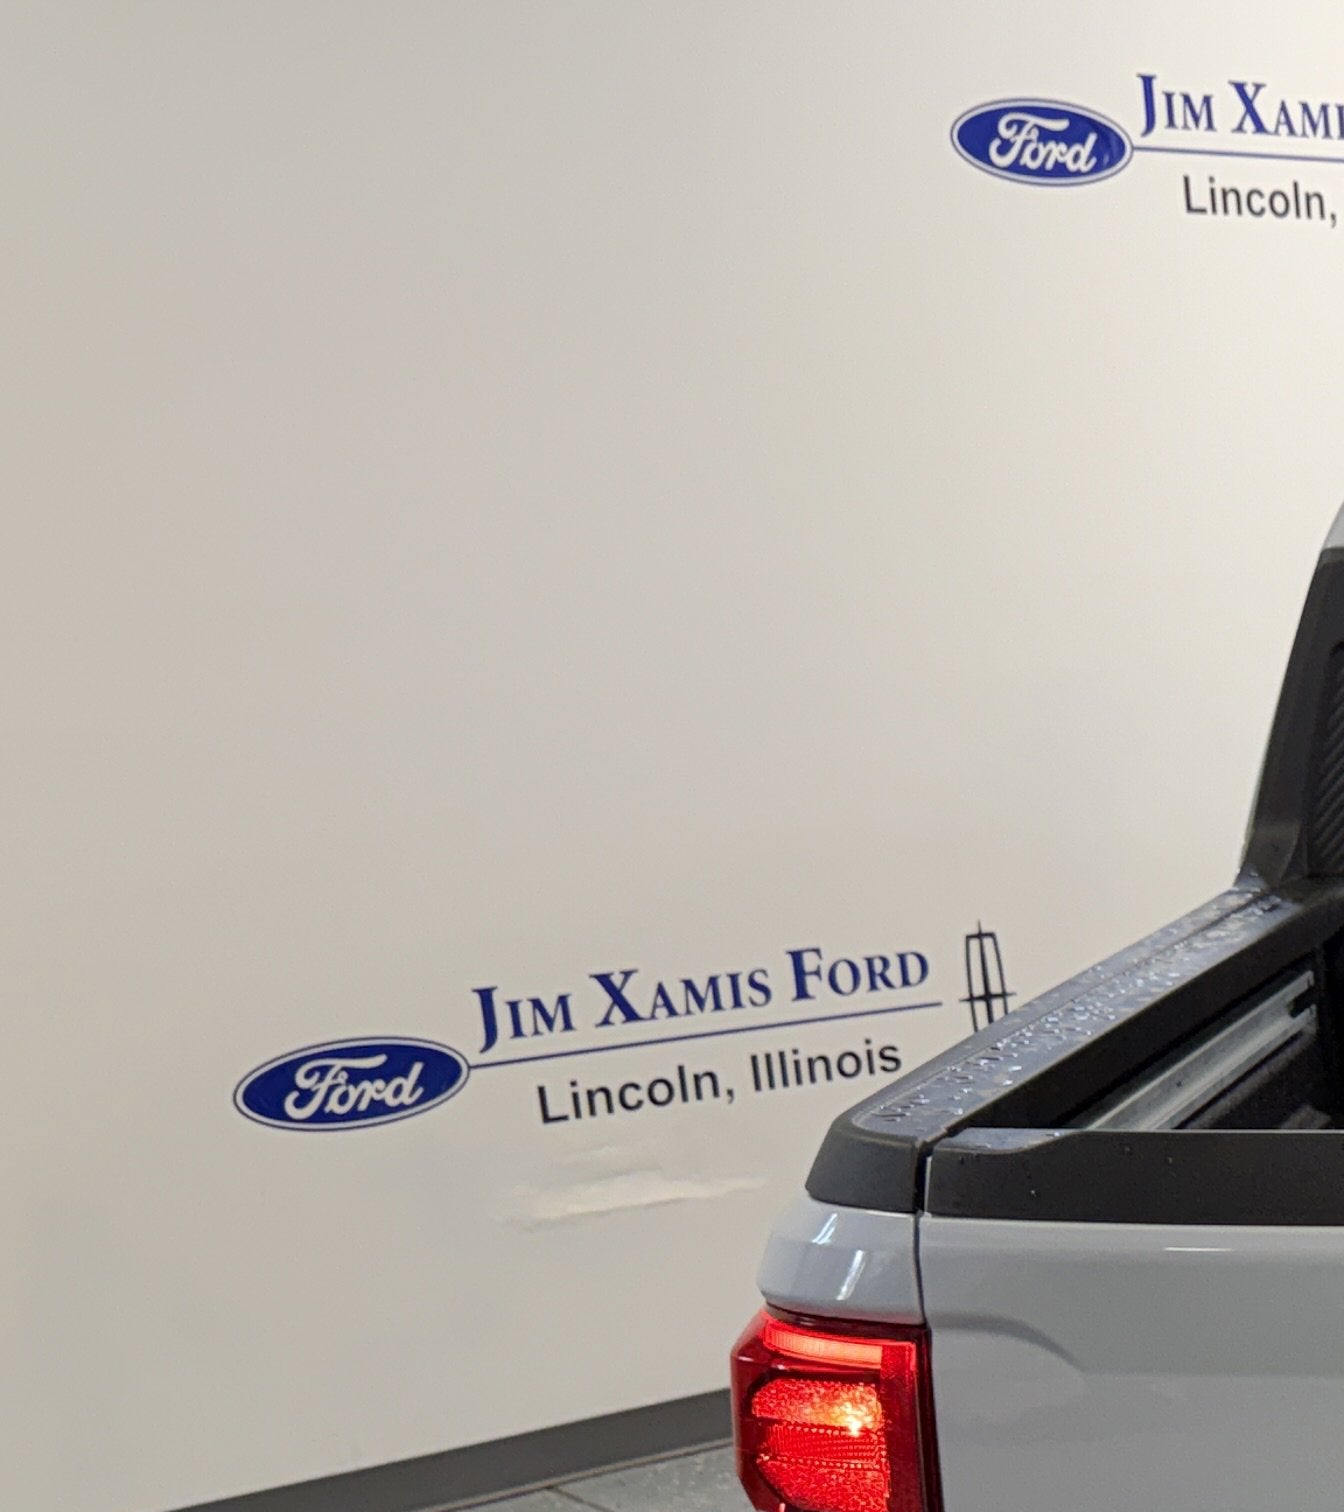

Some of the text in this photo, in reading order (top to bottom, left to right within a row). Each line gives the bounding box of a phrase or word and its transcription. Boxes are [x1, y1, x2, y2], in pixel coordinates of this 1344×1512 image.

[1136, 73, 1216, 138] JIM
[988, 112, 1097, 173] Ford
[1183, 175, 1338, 228] Lincoln,
[472, 946, 930, 1054] JIM XAMIS FORD
[282, 1054, 424, 1122] Ford
[536, 1038, 903, 1127] Lincoln, Illinois
